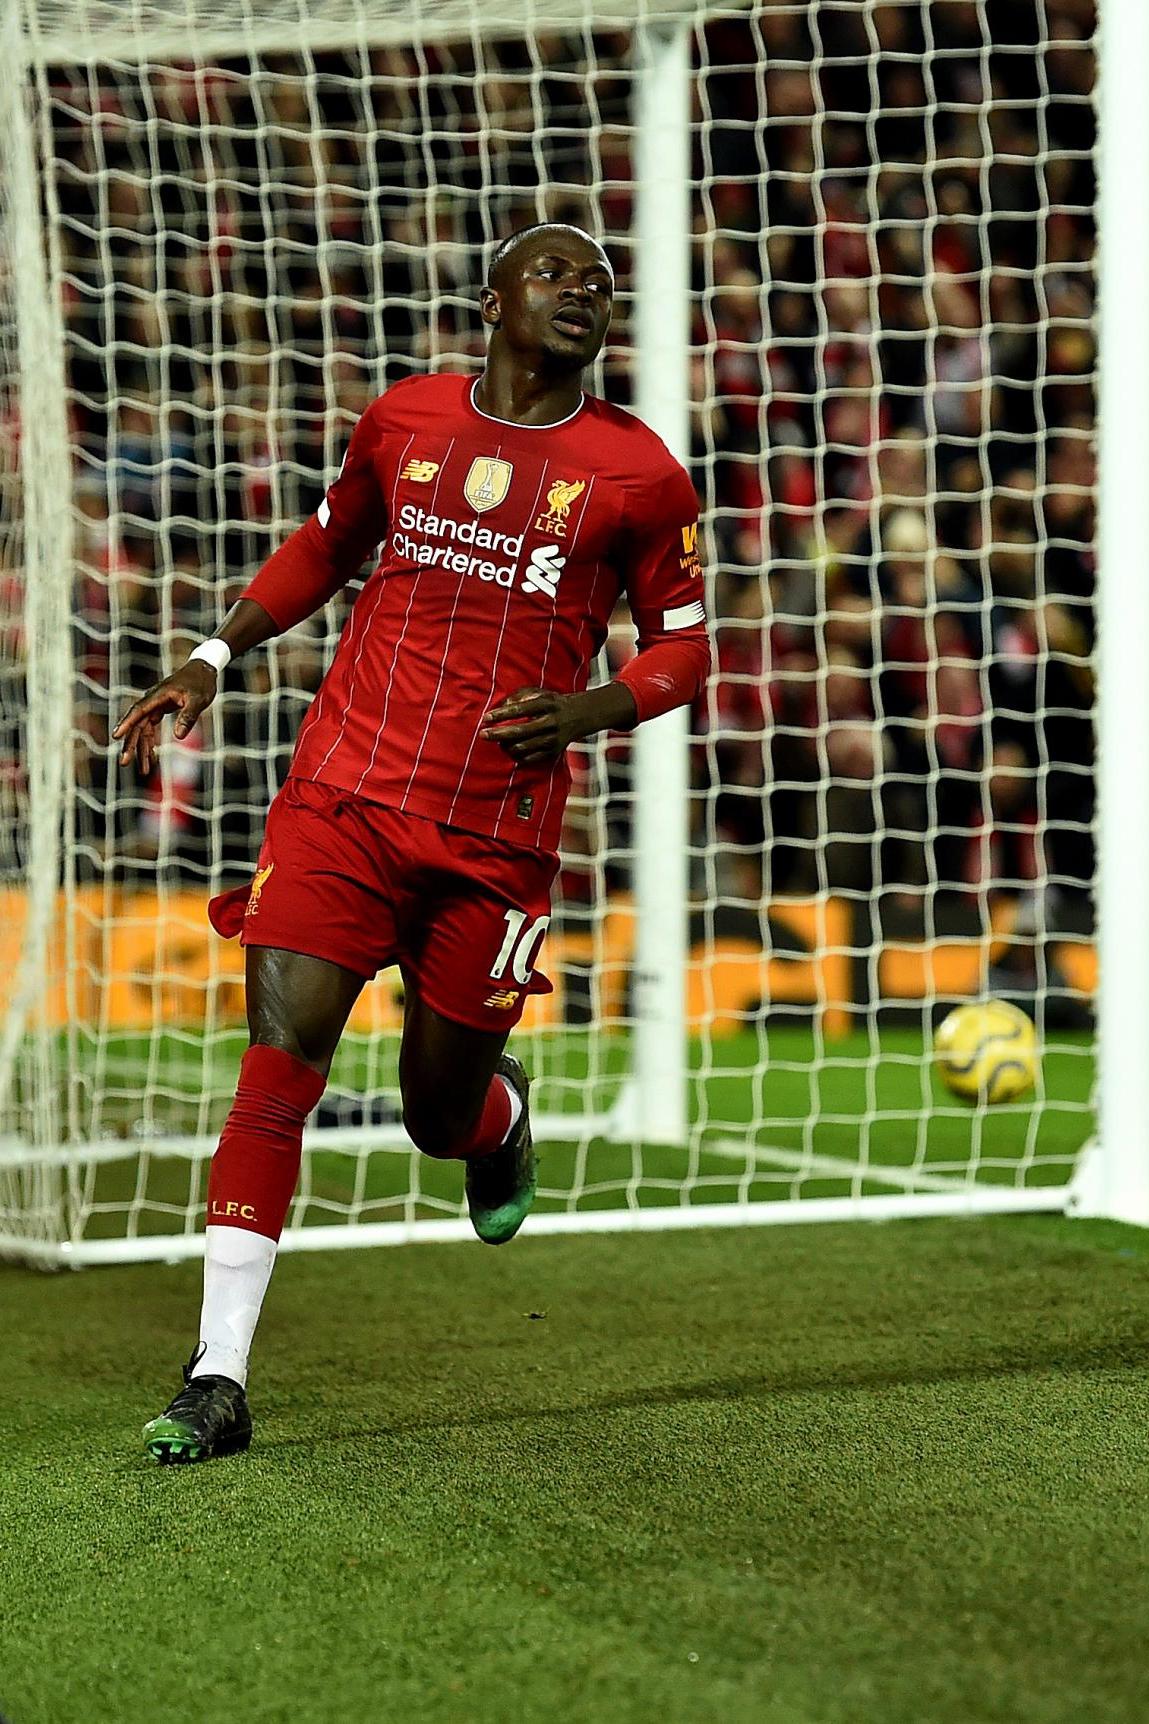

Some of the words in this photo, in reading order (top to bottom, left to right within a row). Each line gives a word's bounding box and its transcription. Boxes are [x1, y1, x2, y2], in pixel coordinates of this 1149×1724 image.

[398, 504, 525, 558] Standard
[393, 532, 517, 589] Chartered
[489, 908, 551, 985] 10
